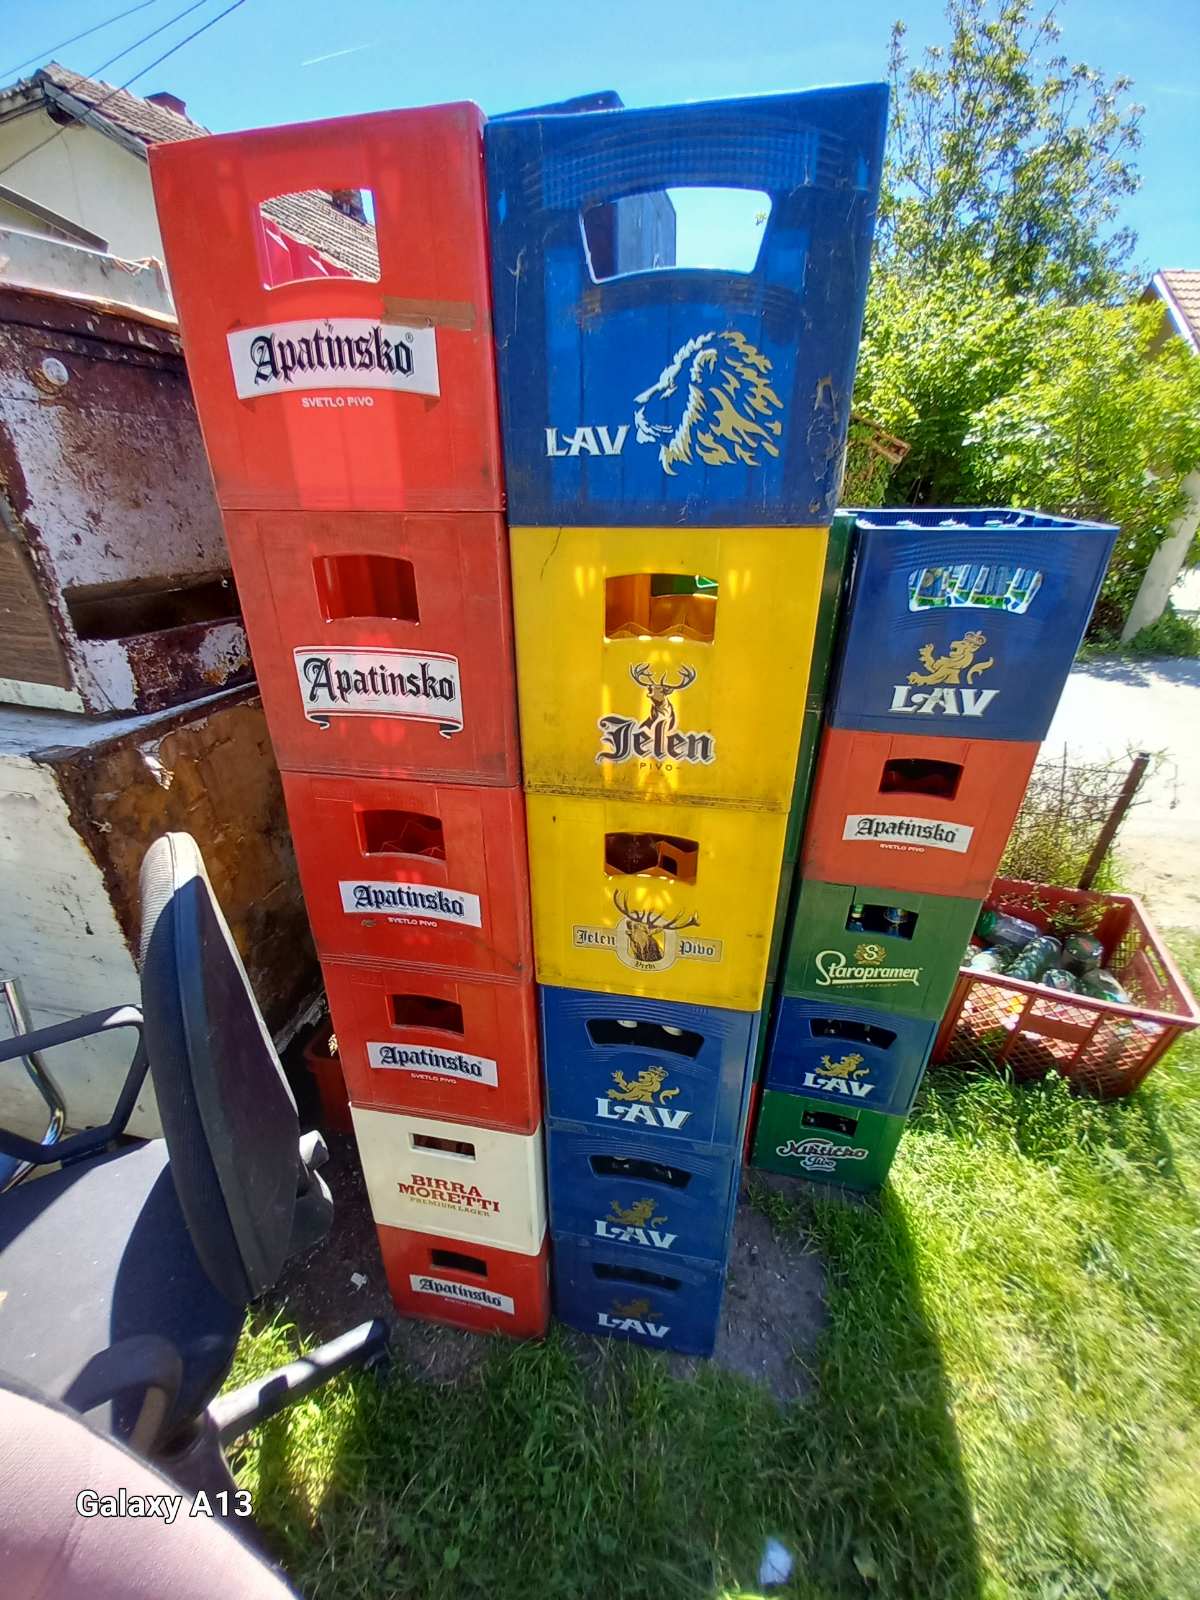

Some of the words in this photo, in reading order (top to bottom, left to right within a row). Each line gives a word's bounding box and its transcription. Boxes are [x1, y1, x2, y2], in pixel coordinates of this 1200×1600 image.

[250, 321, 414, 386] Apatinsko
[302, 396, 344, 408] SVETLO
[346, 396, 374, 407] PIVO
[545, 425, 629, 457] LAV
[303, 657, 455, 703] Apatinsko
[889, 685, 1000, 717] LAV
[596, 714, 716, 764] Jelen
[639, 762, 673, 772] PIVO
[853, 817, 957, 844] Apatinsko
[353, 884, 464, 918] Apatinsko
[576, 929, 616, 946] Jelen
[679, 939, 714, 956] Pivo
[815, 950, 920, 986] Staropramen
[379, 1045, 482, 1077] Apatinsko
[803, 1071, 876, 1098] LAV
[595, 1096, 694, 1130] LAV
[397, 1182, 501, 1213] MORETTI
[411, 1174, 482, 1198] BIRRA
[457, 1206, 491, 1217] LAGER
[594, 1219, 678, 1250] LAV
[419, 1278, 502, 1307] Apatinsko
[597, 1312, 671, 1338] LAV
